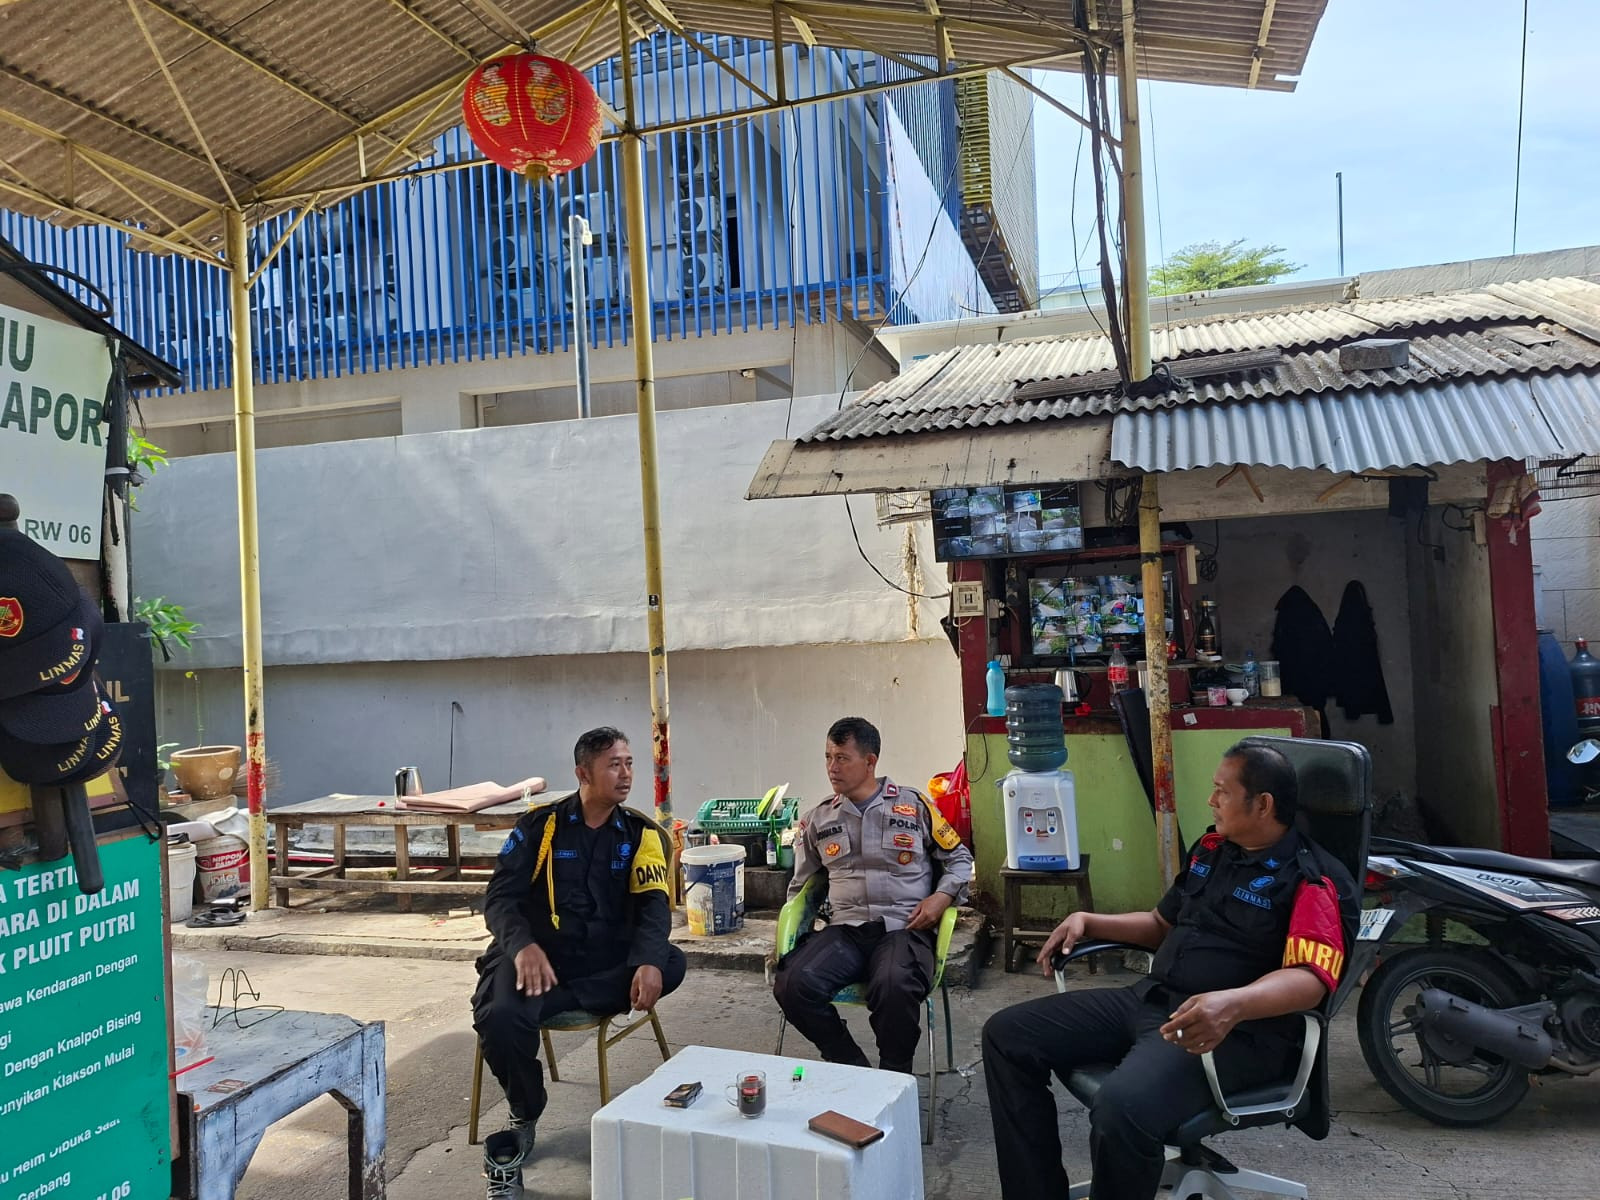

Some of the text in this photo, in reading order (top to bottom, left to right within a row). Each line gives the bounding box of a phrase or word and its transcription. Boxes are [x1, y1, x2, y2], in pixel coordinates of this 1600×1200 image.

[0, 381, 103, 447] APOR
[24, 519, 92, 544] RW 06
[40, 643, 84, 681] LINMAS
[96, 716, 121, 759] LINMAS
[14, 866, 78, 899] TERTI
[47, 900, 67, 923] DI
[75, 879, 140, 915] DALAM
[13, 931, 73, 970] PLUIT
[80, 912, 135, 947] PUTRI
[1283, 937, 1344, 979] ANRU
[26, 971, 92, 1003] Kendaraan
[95, 954, 138, 978] Dengan
[5, 1010, 142, 1077] Dengan Knalpot Bising
[53, 1061, 101, 1091] Klakson
[104, 1044, 135, 1067] Mulai
[17, 1171, 71, 1200] Gerbang
[111, 1180, 131, 1200] 06
